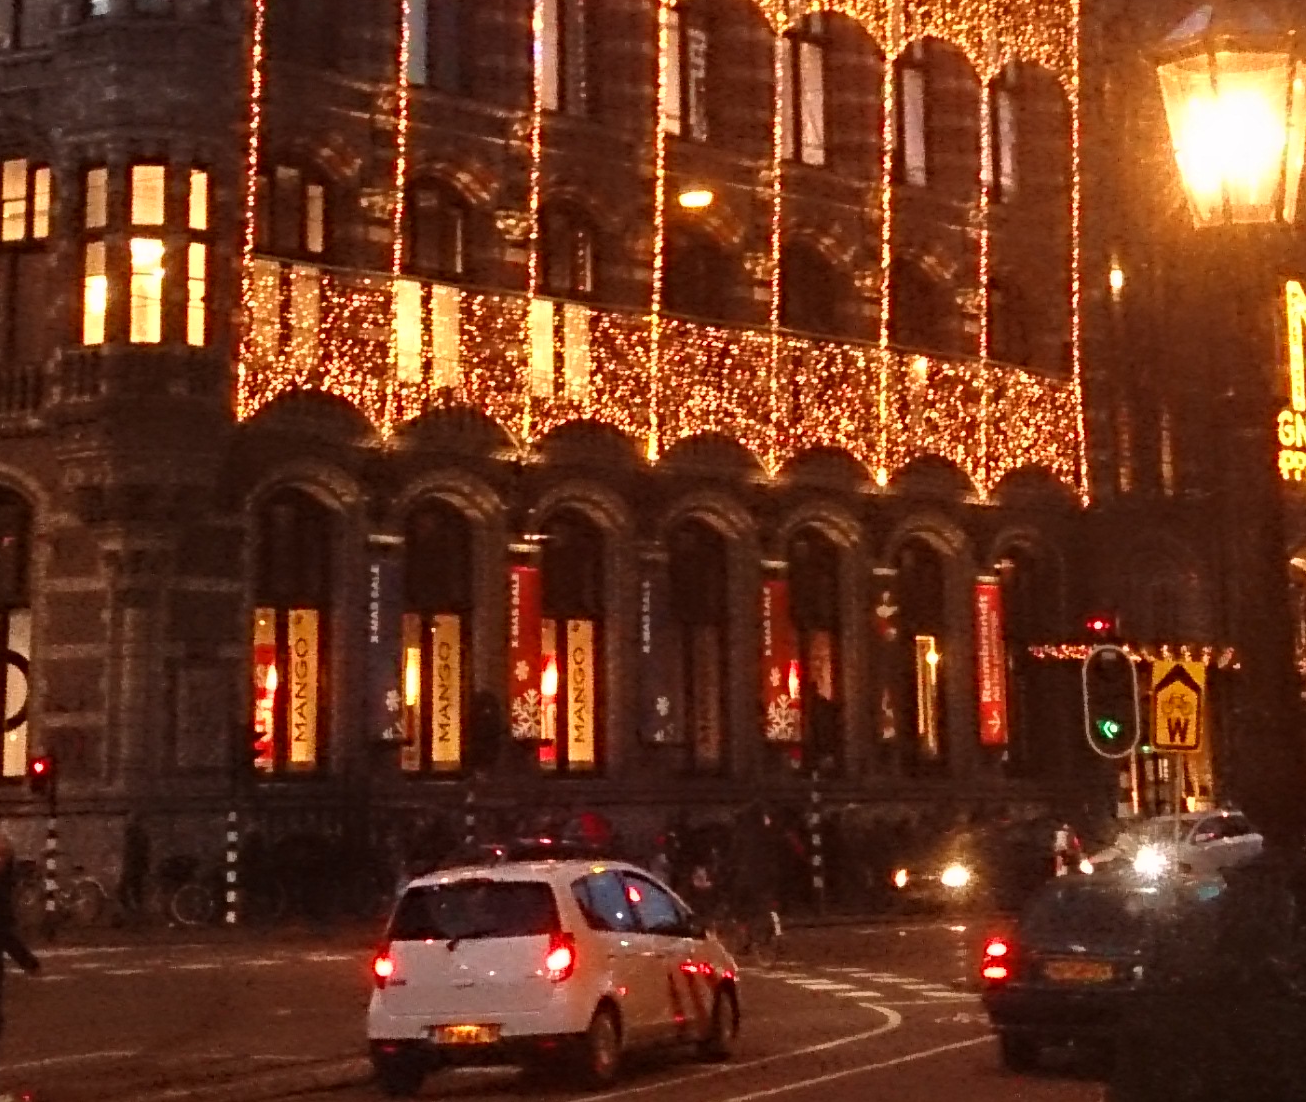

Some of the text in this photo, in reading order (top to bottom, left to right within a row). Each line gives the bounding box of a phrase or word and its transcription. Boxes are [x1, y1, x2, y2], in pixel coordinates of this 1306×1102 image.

[294, 637, 309, 743] MANGO
[438, 641, 452, 743] MANGO
[572, 646, 586, 744] MANGO
[1166, 717, 1190, 743] W
